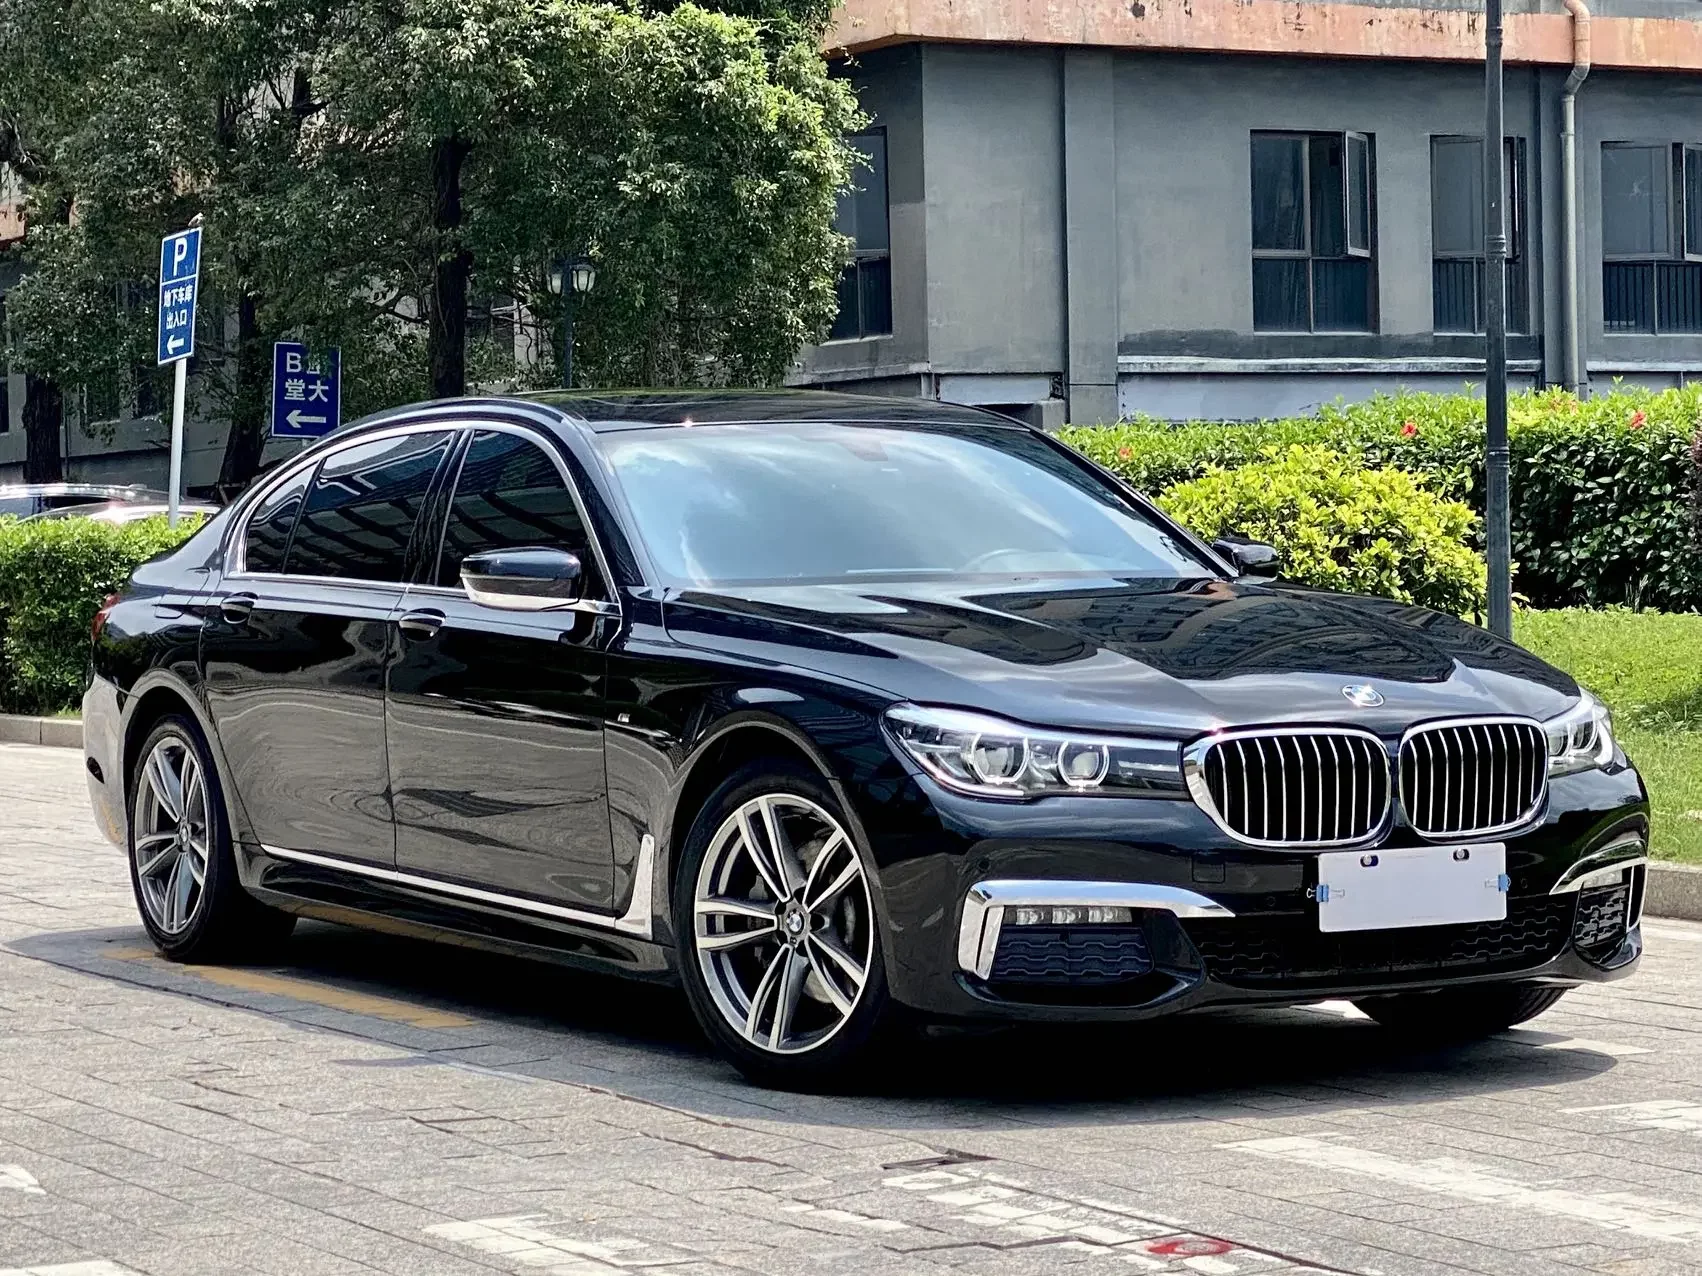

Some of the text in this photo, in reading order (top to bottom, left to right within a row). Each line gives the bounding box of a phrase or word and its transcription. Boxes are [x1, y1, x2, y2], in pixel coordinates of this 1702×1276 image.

[173, 237, 188, 276] P
[163, 284, 193, 307] 地下车库
[166, 309, 187, 329] 出入口
